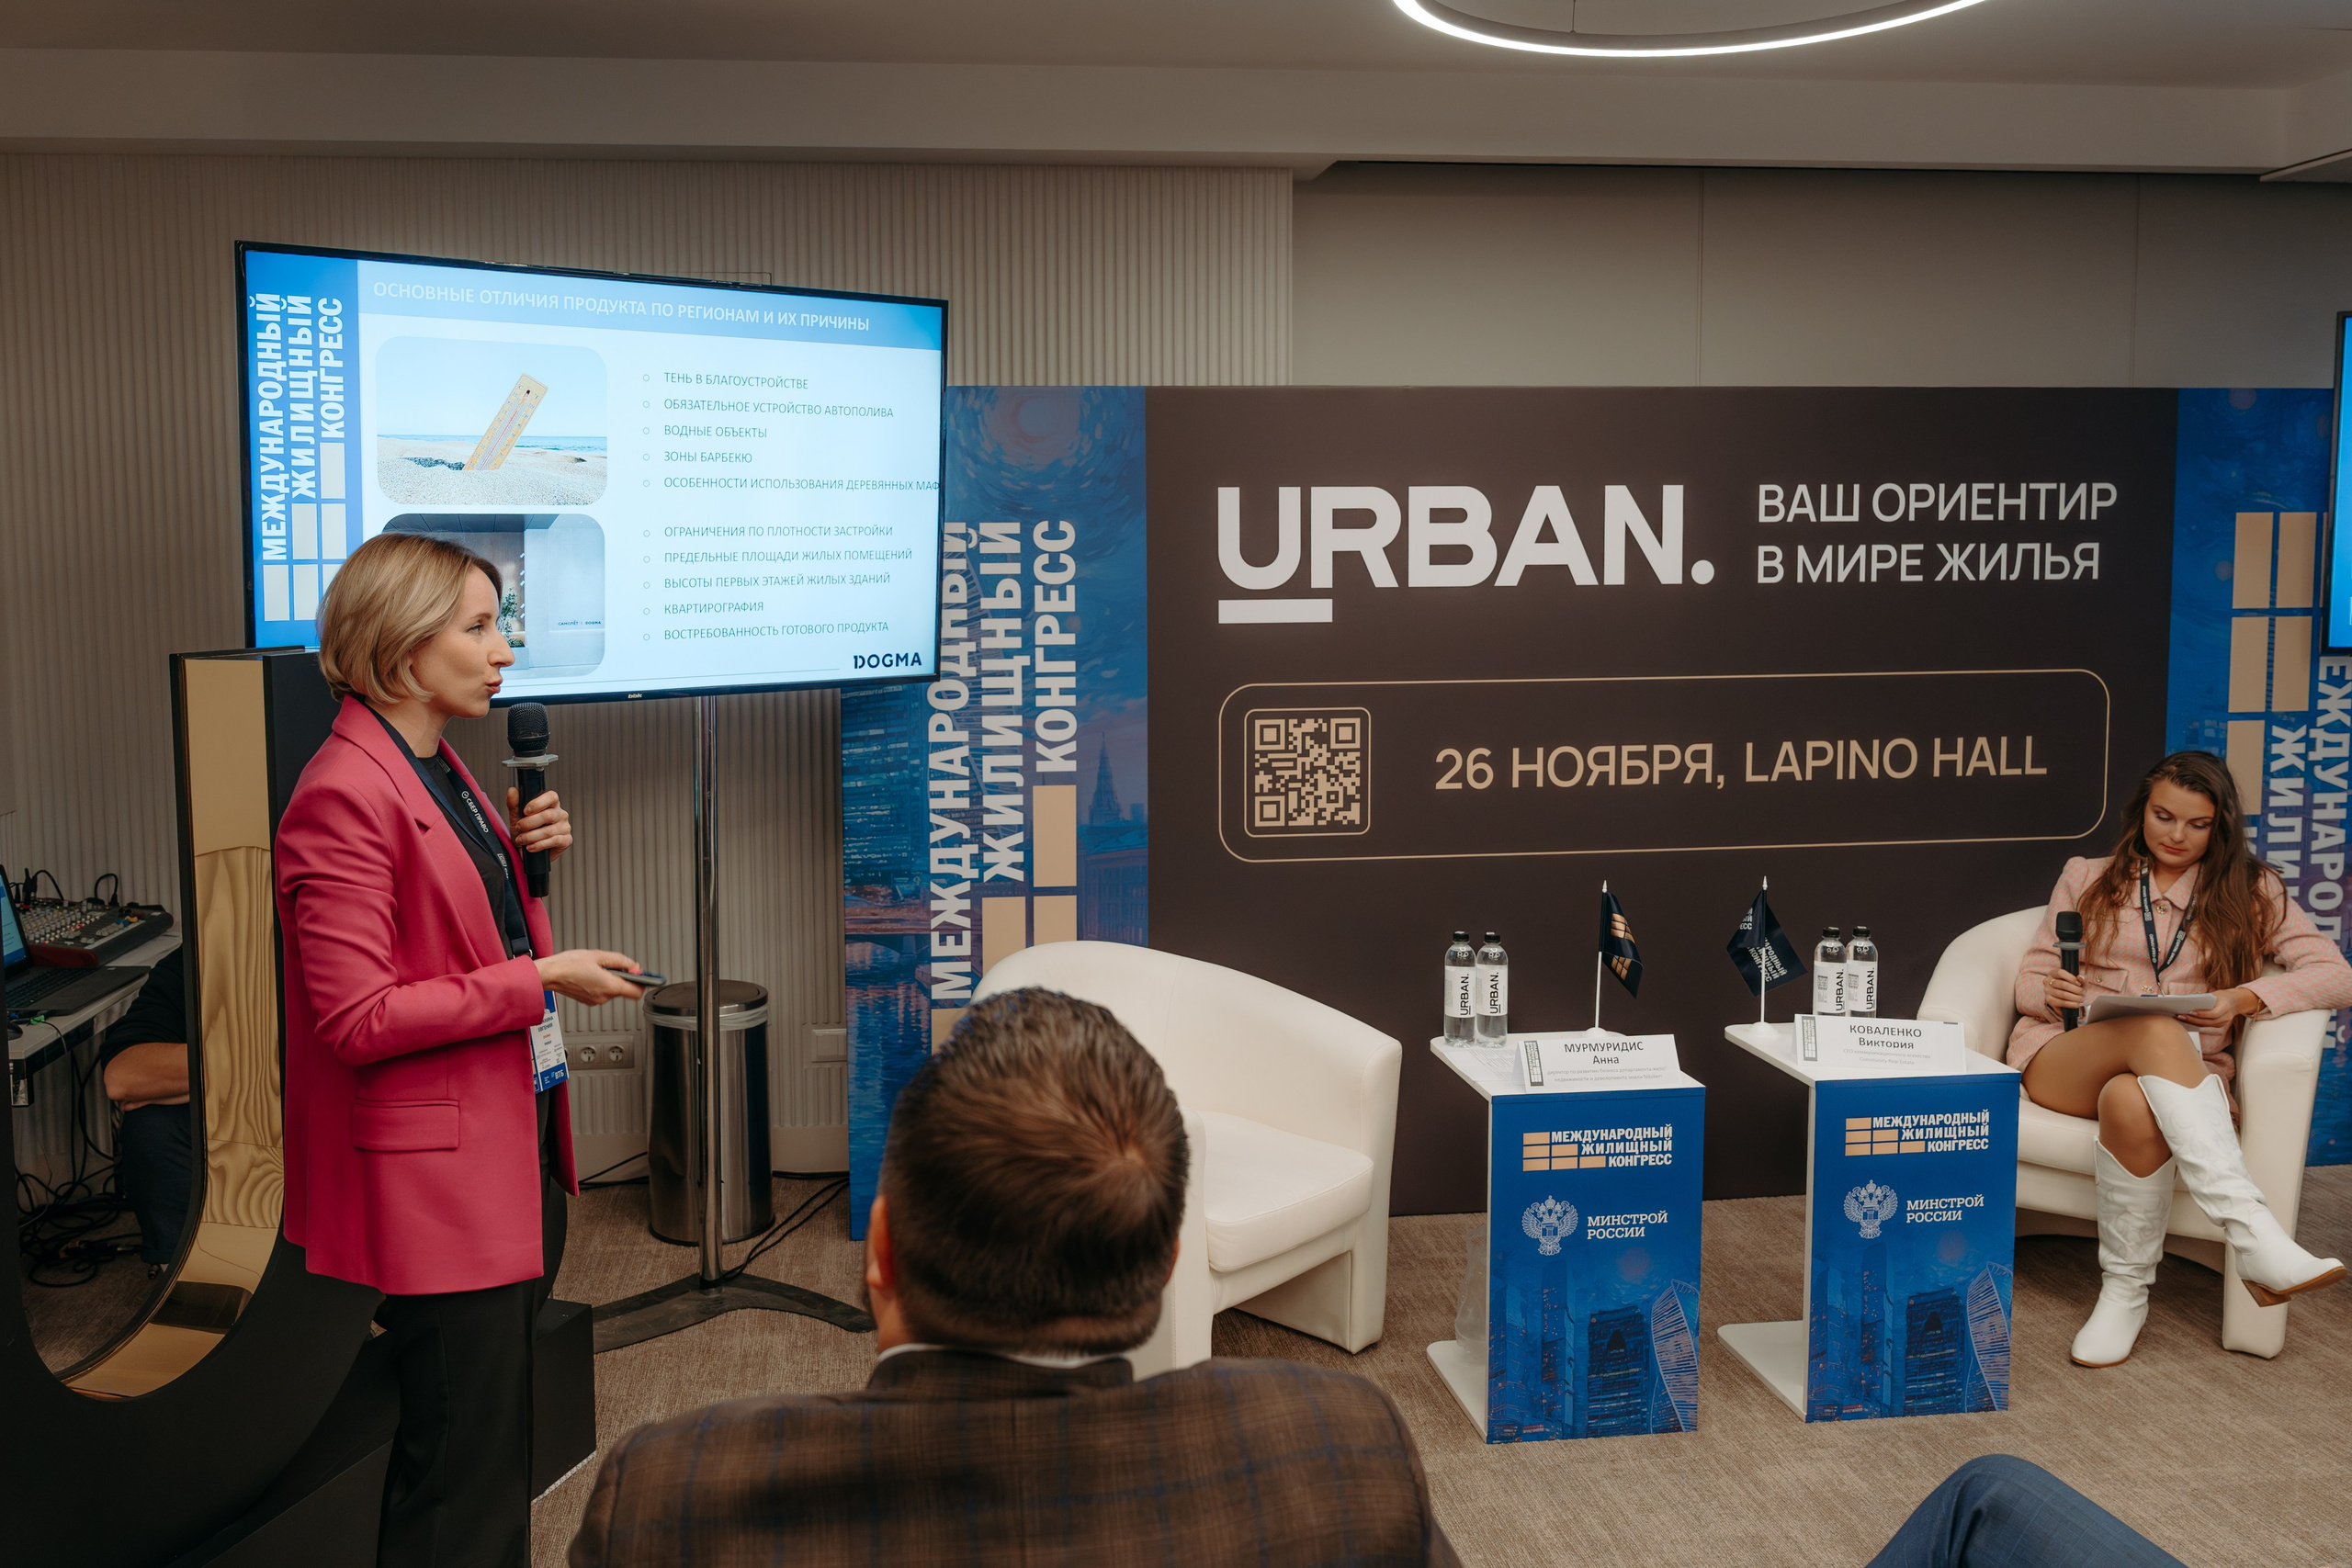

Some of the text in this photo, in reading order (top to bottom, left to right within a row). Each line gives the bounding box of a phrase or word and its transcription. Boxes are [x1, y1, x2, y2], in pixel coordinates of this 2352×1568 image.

[373, 282, 869, 332] ОСНОВНЫЕ ОТЛИЧИЯ ПРОДУКТА ПО РЕГИОНАМ И ИХ ПРИЧИНЫ
[318, 298, 345, 439] КОНГРЕСС
[663, 372, 808, 389] ТЕНЬ В БЛАГОУСТРОЙСТВЕ
[281, 295, 319, 499] ЖИЛИЩНЫЙ
[663, 399, 894, 418] ОБЯЗАТЕЛЬНОЕ УСТРОЙСТВО АВТОПОЛИВА
[249, 293, 290, 560] МЕЖДУНАРОДНЫЙ
[663, 425, 767, 438] ВОДНЫЕ ОБЪЕКТЫ
[663, 451, 752, 464] ЗОНЫ БАРБЕКЮ
[663, 477, 748, 489] ОСОБЕННОСТИ
[751, 479, 843, 490] ИСПОЛЬЗОВАНИЯ
[846, 479, 913, 491] ДЕРЕВЯННЫХ
[1758, 482, 2118, 523] ВАШ ОРИЕНТИР
[664, 524, 893, 537] ОГРАНИЧЕНИЯ ПО ПЛОТНОСТИ ЗАСТРОЙКИ
[1217, 484, 1714, 590] URBAN.
[664, 547, 912, 565] ПРЕДЕЛЬНЫЕ ПЛОЩАДИ ЖИЛЫХ ПОМЕЩЕНИЙ
[1758, 542, 2099, 583] В МИРЕ ЖИЛЬЯ
[664, 572, 890, 589] ВЫСОТЫ ПЕРВЫХ ЭТАЖЕЙ ЖИЛЫХ ЗДАНИЙ
[664, 602, 764, 615] КВАРТИРОГРАФИЯ
[664, 622, 889, 640] ВОСТРЕБОВАННОСТЬ ГОТОВОГО ПРОДУКТА
[1033, 520, 1077, 773] КОНГРЕСС
[853, 652, 922, 670] DOGMA
[968, 523, 1030, 882] ЖИЛИЩНЫЙ
[1435, 743, 1724, 790] 26 НОЯБРЯ,
[1746, 736, 2047, 783] LAPINO HALL
[466, 797, 489, 833] СБЕР ПРАВО
[2307, 656, 2352, 1048] ЕЖДУНАРОД
[1460, 974, 1470, 1016] URBAN.
[1489, 972, 1499, 1013] URBAN.
[1836, 969, 1844, 1011] URBAN.
[1866, 967, 1875, 1010] URBAN.
[1849, 1025, 1922, 1038] КОВАЛЕНКО
[1565, 1041, 1644, 1053] МУРМУРИДИС
[1859, 1037, 1914, 1049] Виктория
[1593, 1055, 1620, 1065] Анна
[1872, 1110, 1990, 1129] МЕЖДУНАРОДНЫЙ
[1551, 1123, 1673, 1145] МЕЖДУНАРОДНЫЙ
[1901, 1124, 1989, 1141] ЖИЛИЩНЫЙ
[1581, 1138, 1672, 1156] ЖИЛИЩНЫЙ
[1928, 1138, 1989, 1153] КОНГРЕСС
[1609, 1154, 1672, 1168] КОНГРЕСС
[1906, 1194, 1984, 1211] МИНСТРОЙ
[1588, 1211, 1668, 1227] МИНСТРОЙ
[1906, 1210, 1962, 1224] РОССИИ
[1587, 1226, 1645, 1240] РОССИИ
